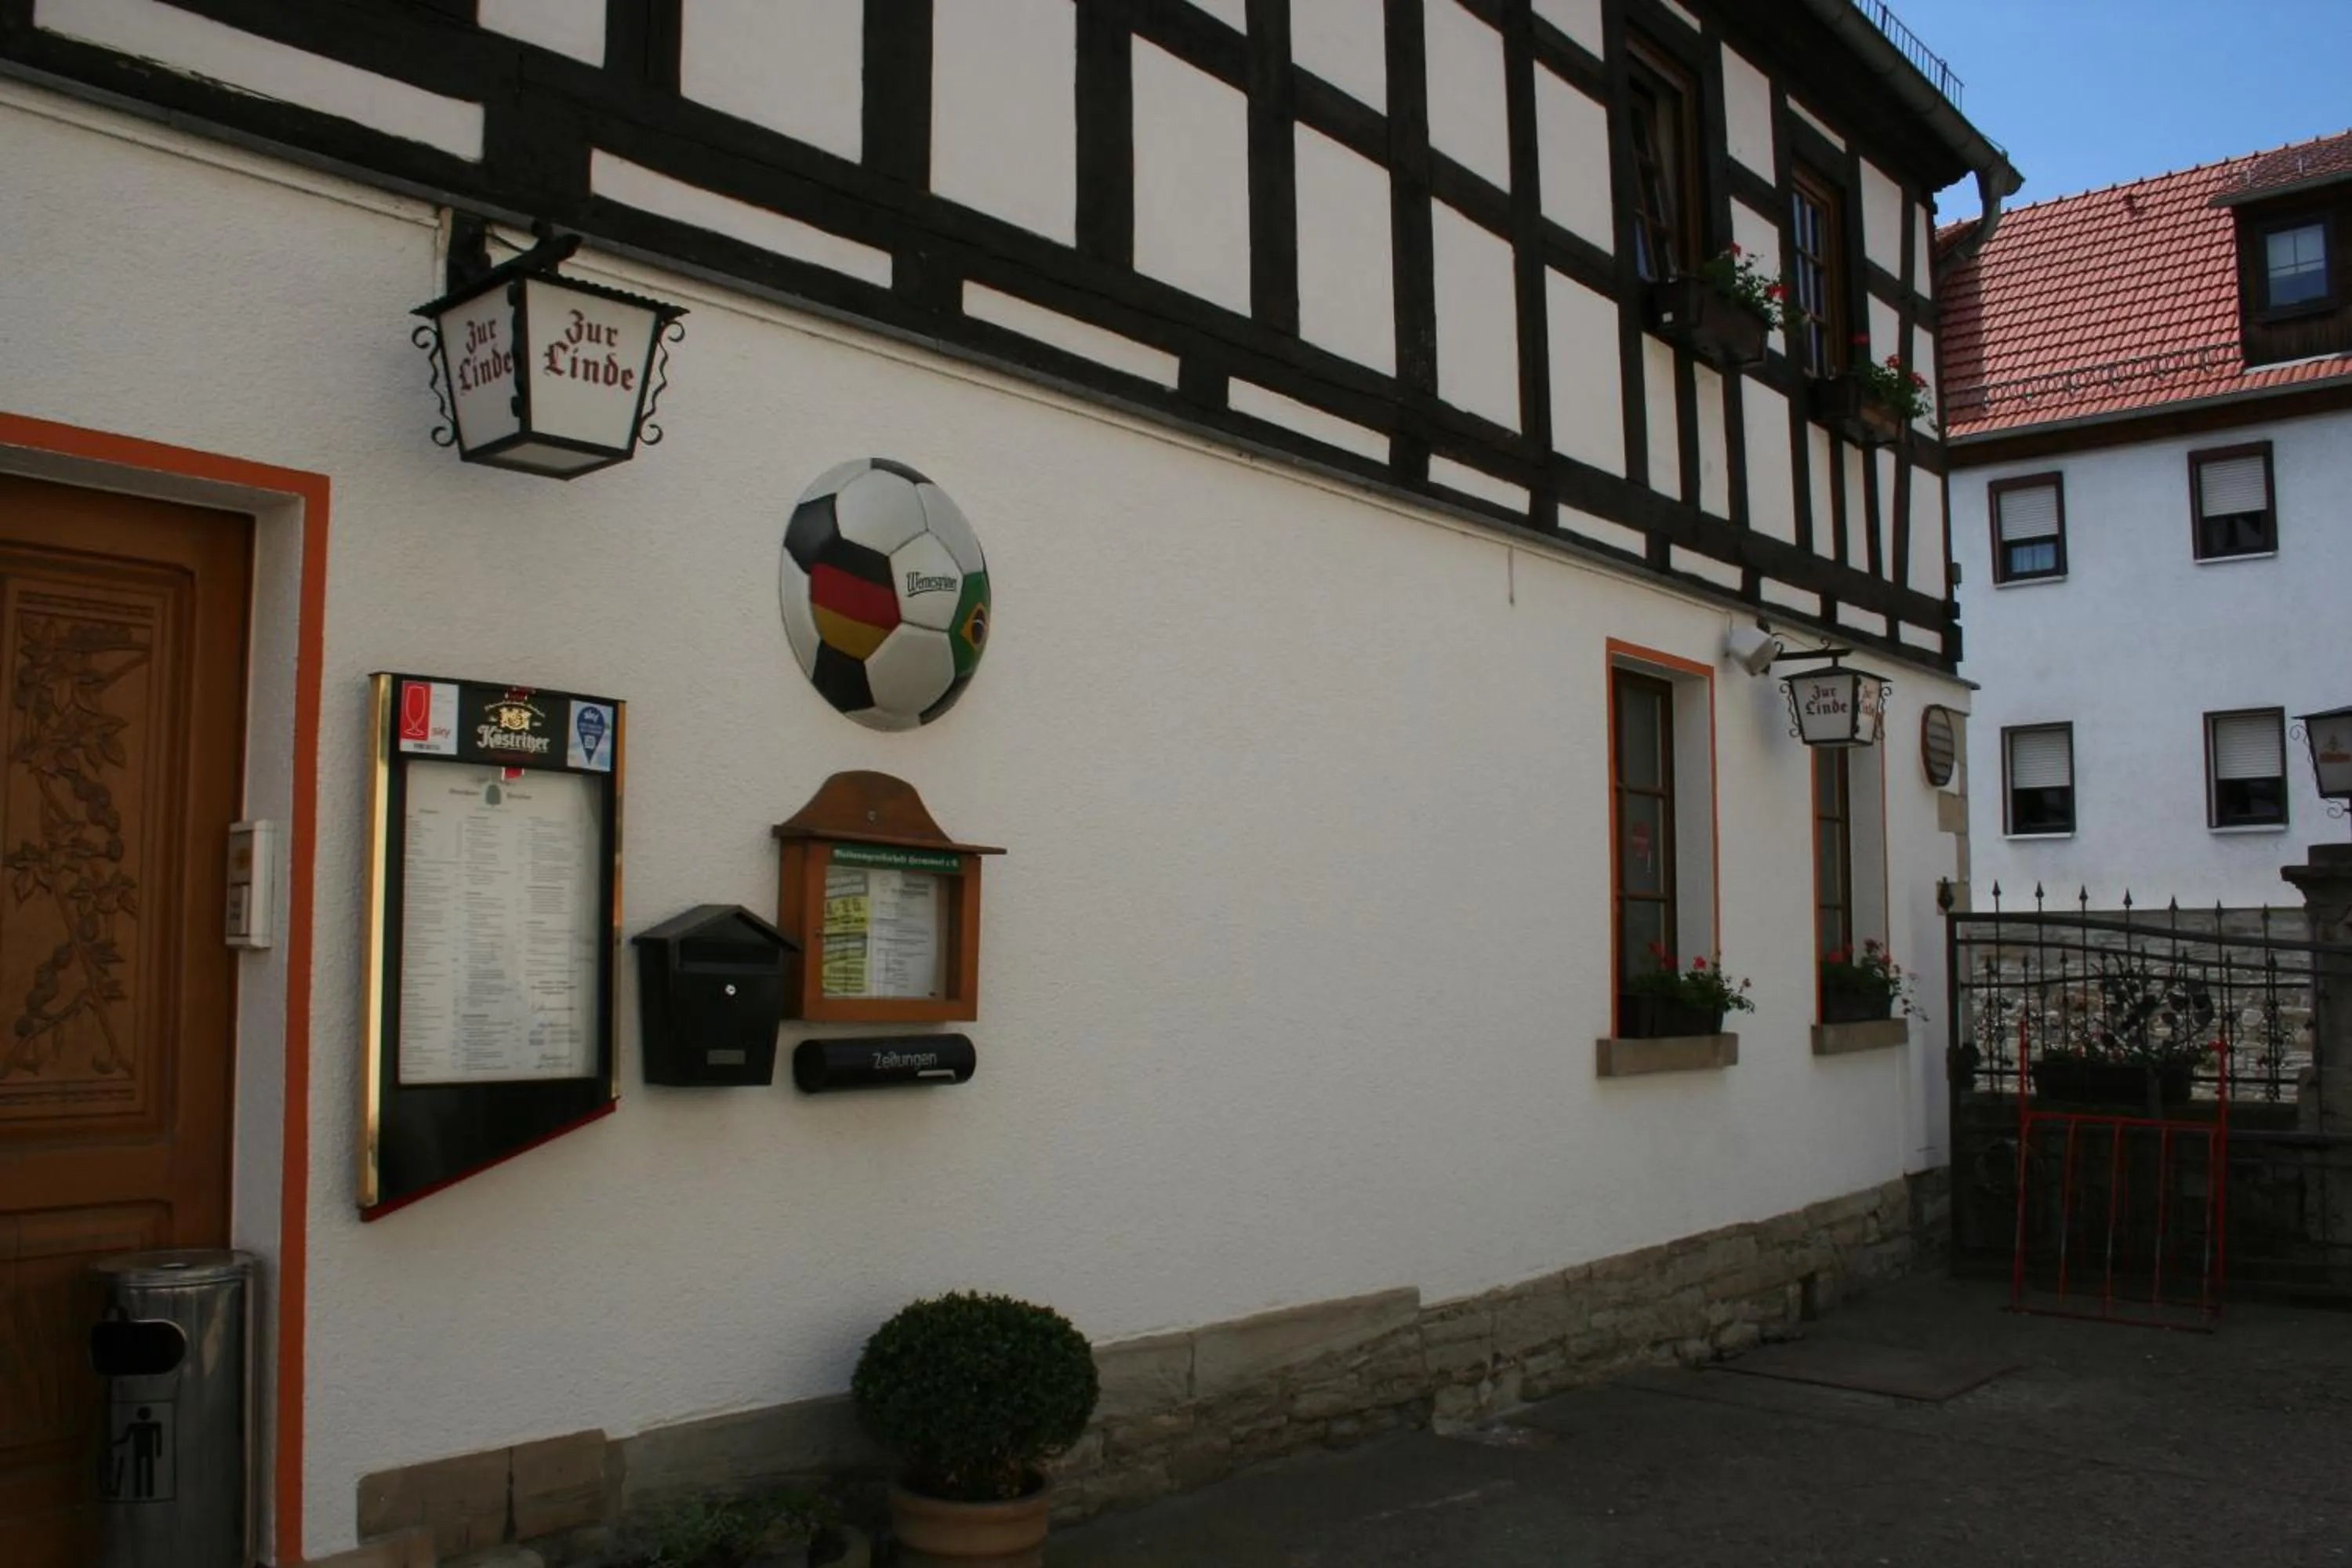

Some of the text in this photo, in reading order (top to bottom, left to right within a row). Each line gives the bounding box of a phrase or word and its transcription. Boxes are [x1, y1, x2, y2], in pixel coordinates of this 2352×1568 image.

[466, 318, 498, 354] Zur
[564, 309, 619, 347] Zur
[459, 343, 514, 395] Linde
[543, 341, 635, 391] Linde
[1806, 699, 1849, 716] Linde
[1811, 684, 1837, 700] Zur
[872, 1051, 938, 1069] Zeitungen
